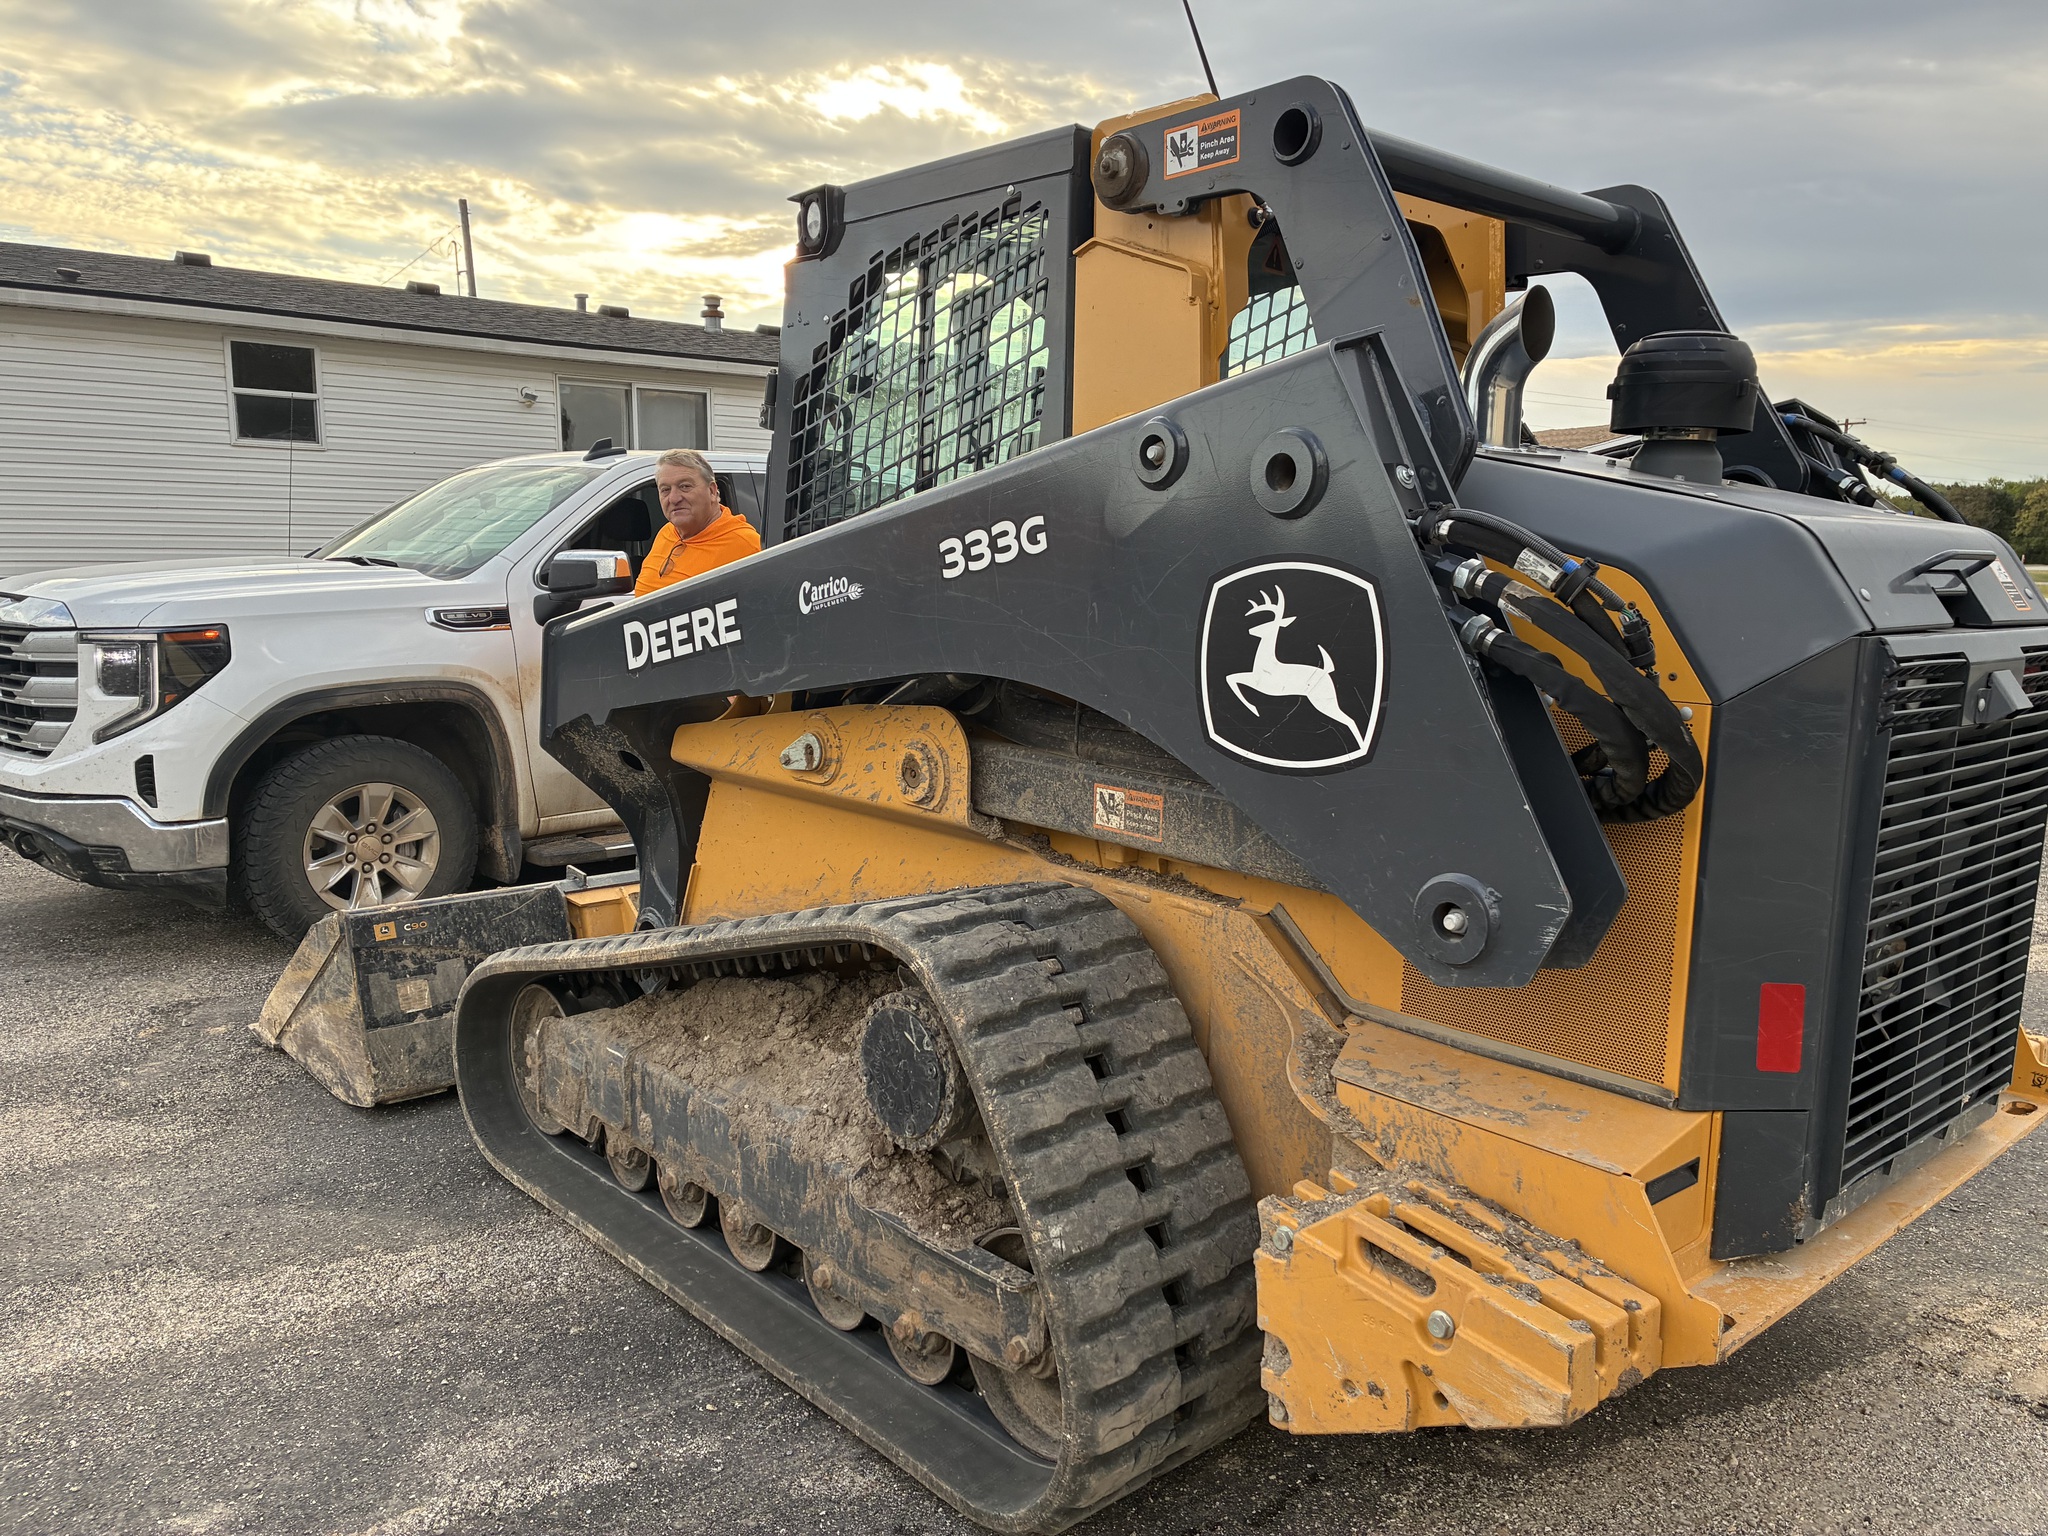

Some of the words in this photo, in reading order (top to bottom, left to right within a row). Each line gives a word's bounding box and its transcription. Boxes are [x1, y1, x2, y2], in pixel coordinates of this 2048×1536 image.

[1207, 115, 1236, 130] WARNING
[1200, 139, 1219, 151] Pinch
[1219, 135, 1235, 145] Area
[1200, 152, 1214, 161] Keep
[1214, 147, 1230, 157] Away
[939, 515, 1048, 580] 333G
[799, 576, 849, 615] Carrico
[812, 596, 848, 611] IMPLEMENT
[623, 598, 742, 671] DEERE
[361, 841, 379, 857] GMC
[404, 920, 428, 931] C90
